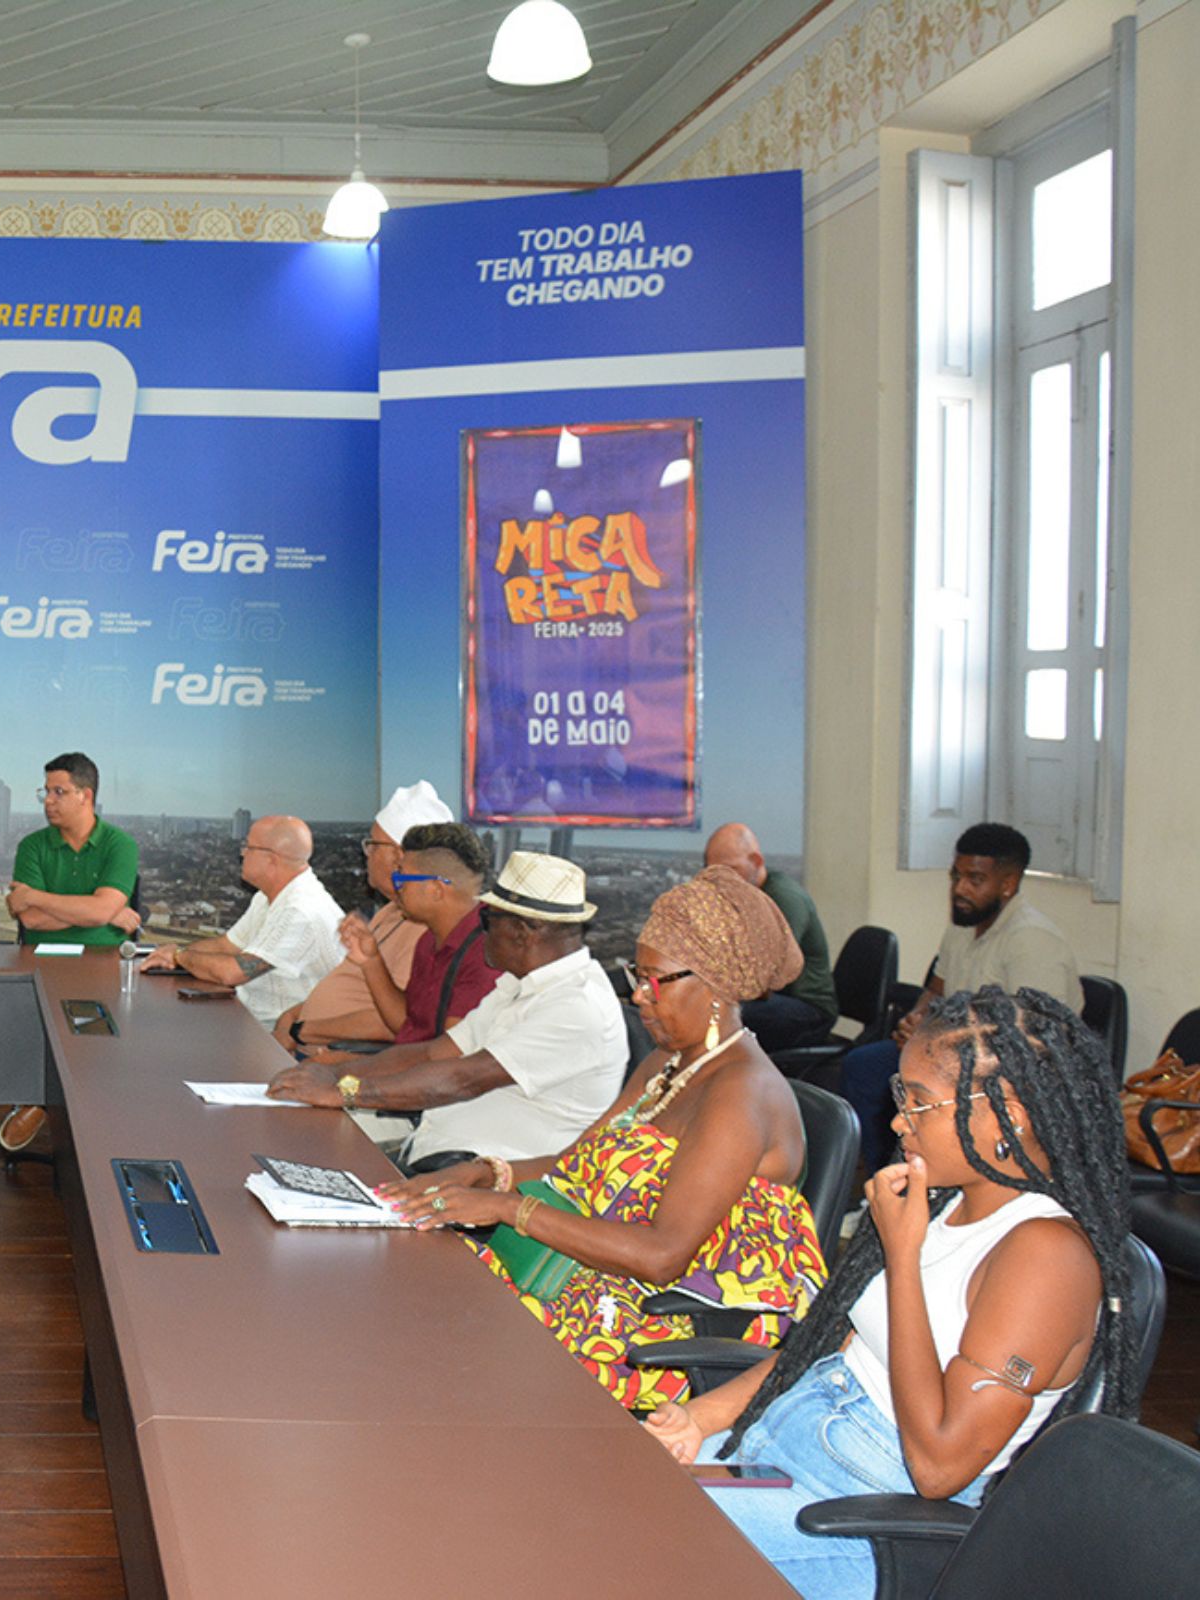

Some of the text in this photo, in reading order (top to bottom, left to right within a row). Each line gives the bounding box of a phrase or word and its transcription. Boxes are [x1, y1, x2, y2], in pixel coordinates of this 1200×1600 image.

[517, 220, 646, 253] TODO DIA
[475, 243, 694, 283] TEM TRABALHO
[505, 273, 666, 307] CHEGANDO
[152, 530, 269, 574] Feira
[503, 571, 639, 624] RETA
[588, 622, 624, 637] 2025
[151, 663, 268, 706] Feira
[533, 691, 560, 715] 01
[594, 690, 626, 715] 04
